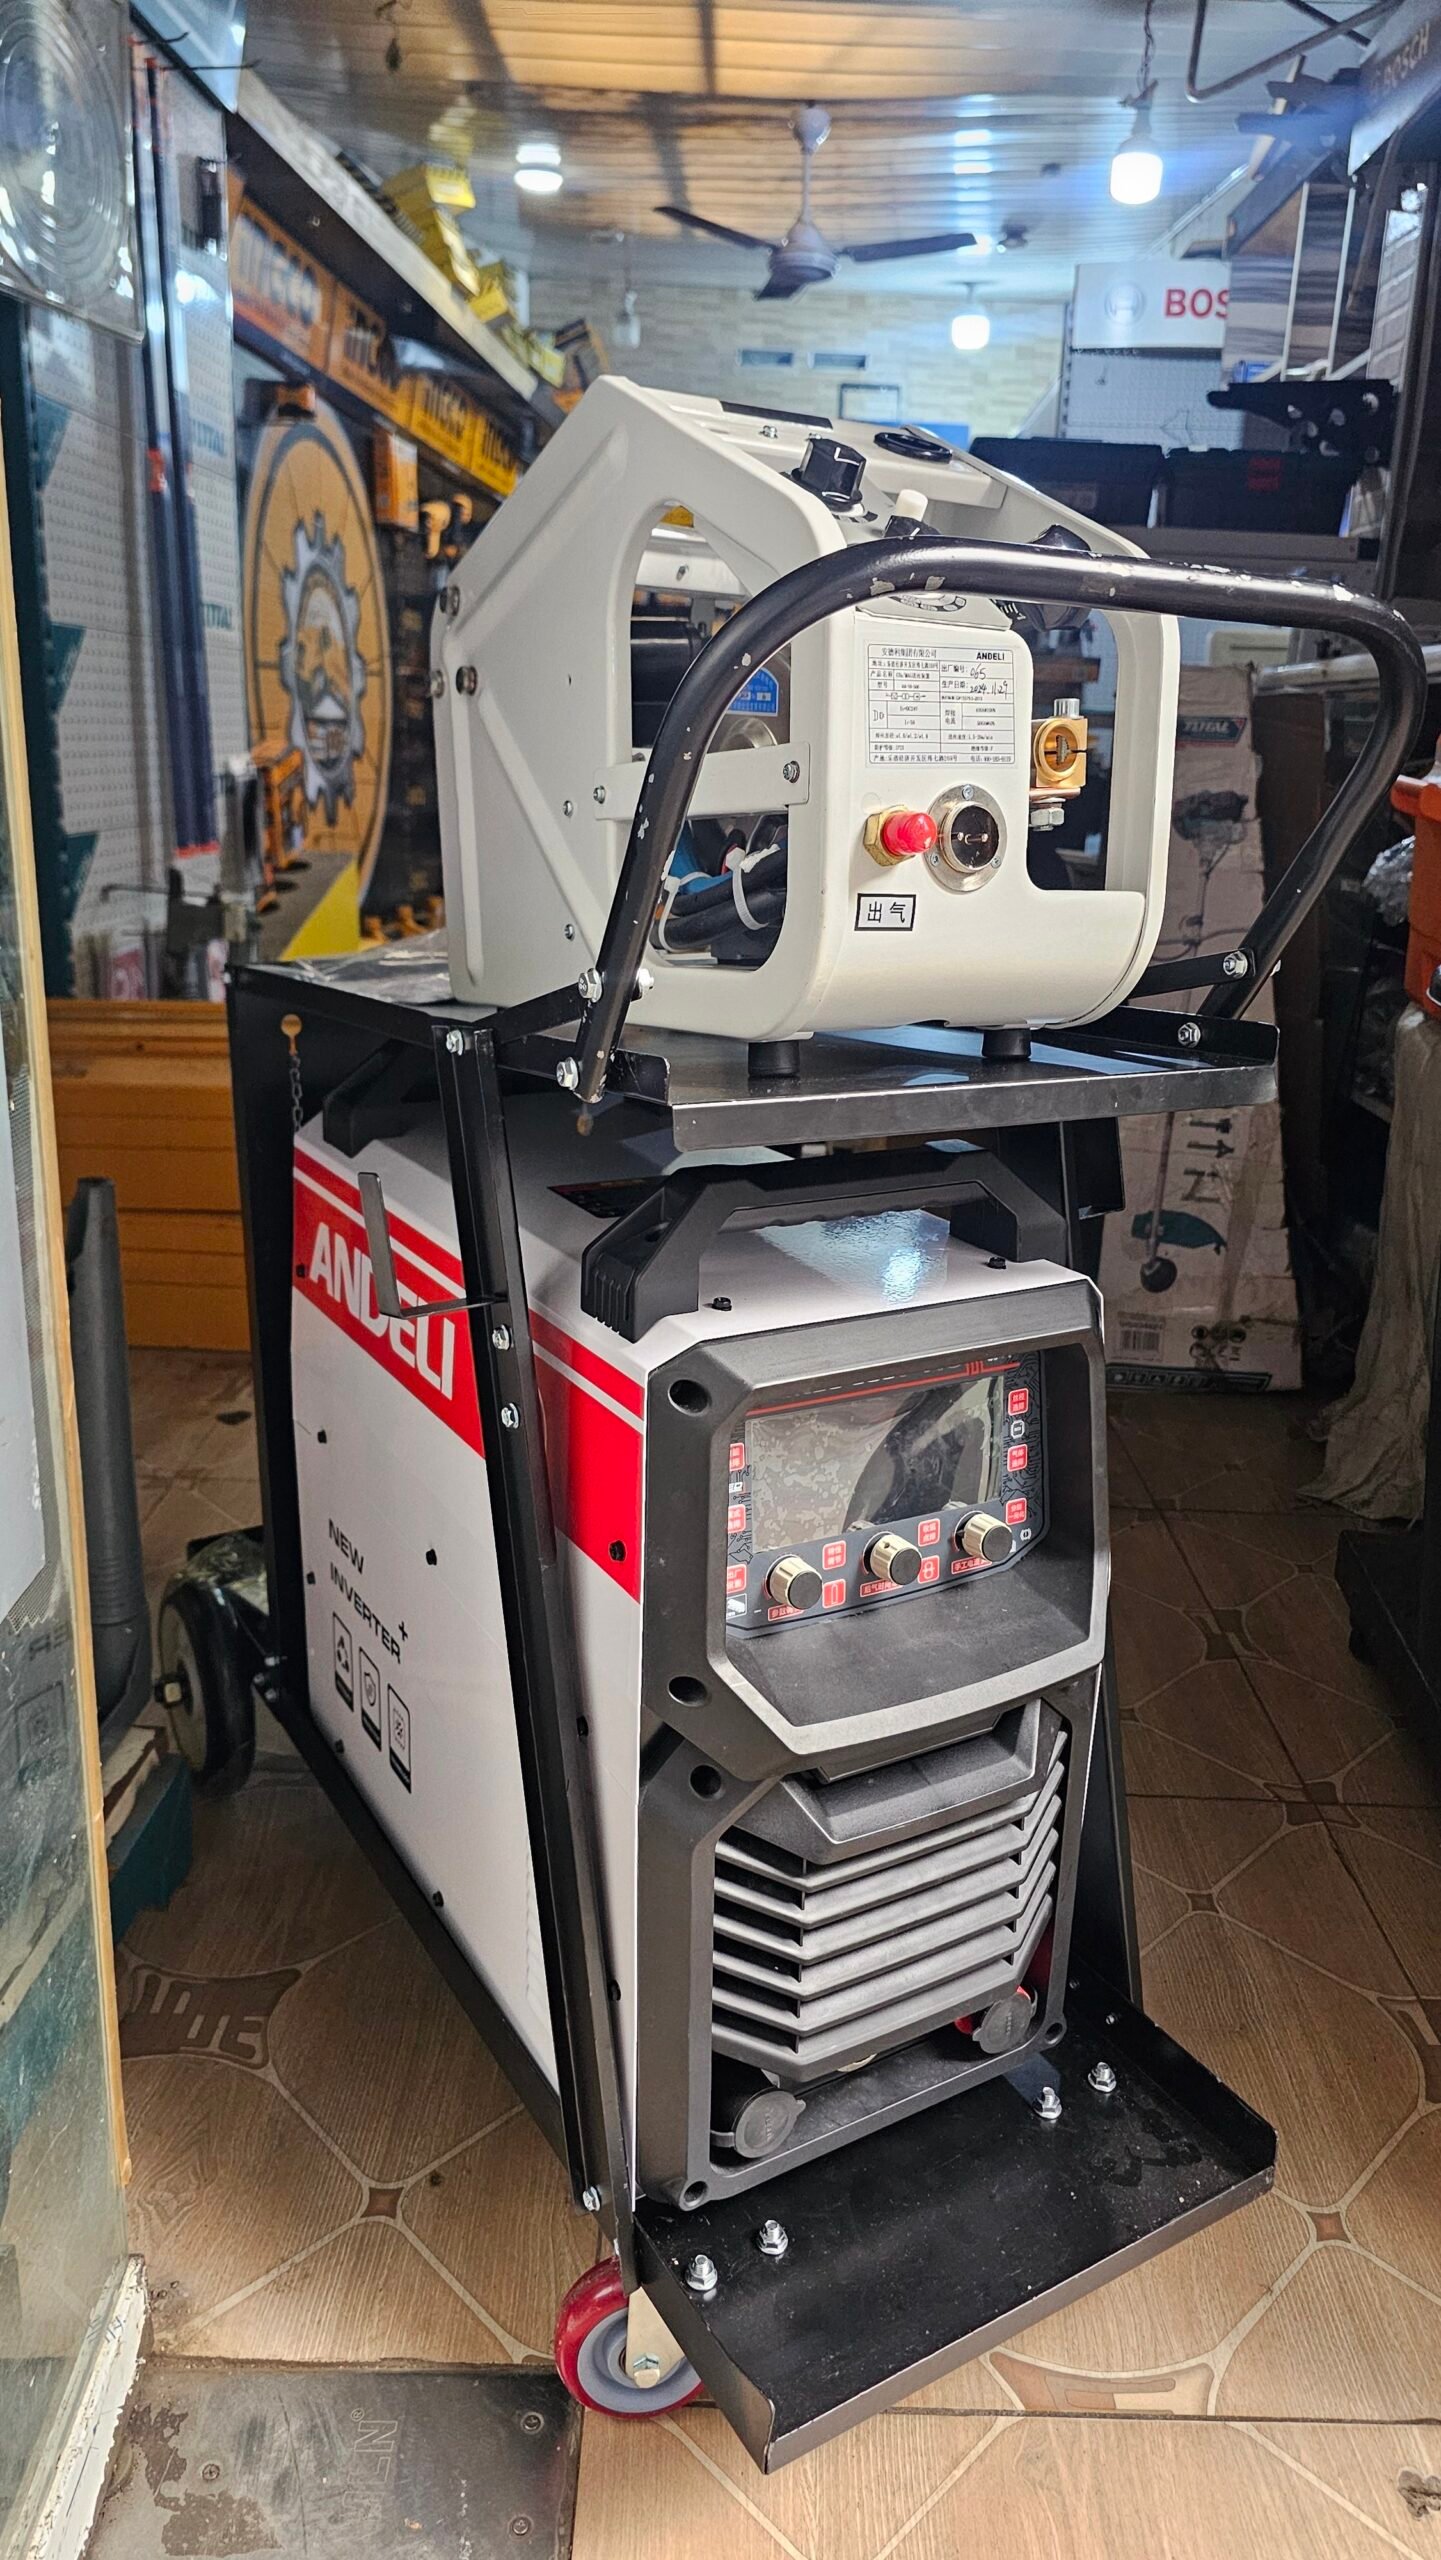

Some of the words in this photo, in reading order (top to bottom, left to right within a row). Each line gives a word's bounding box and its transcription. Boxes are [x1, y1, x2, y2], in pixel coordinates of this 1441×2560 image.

[976, 652, 1005, 661] ANDELI
[867, 900, 906, 923] 出气
[309, 1221, 455, 1401] ANDELI
[329, 1517, 364, 1575] NEW
